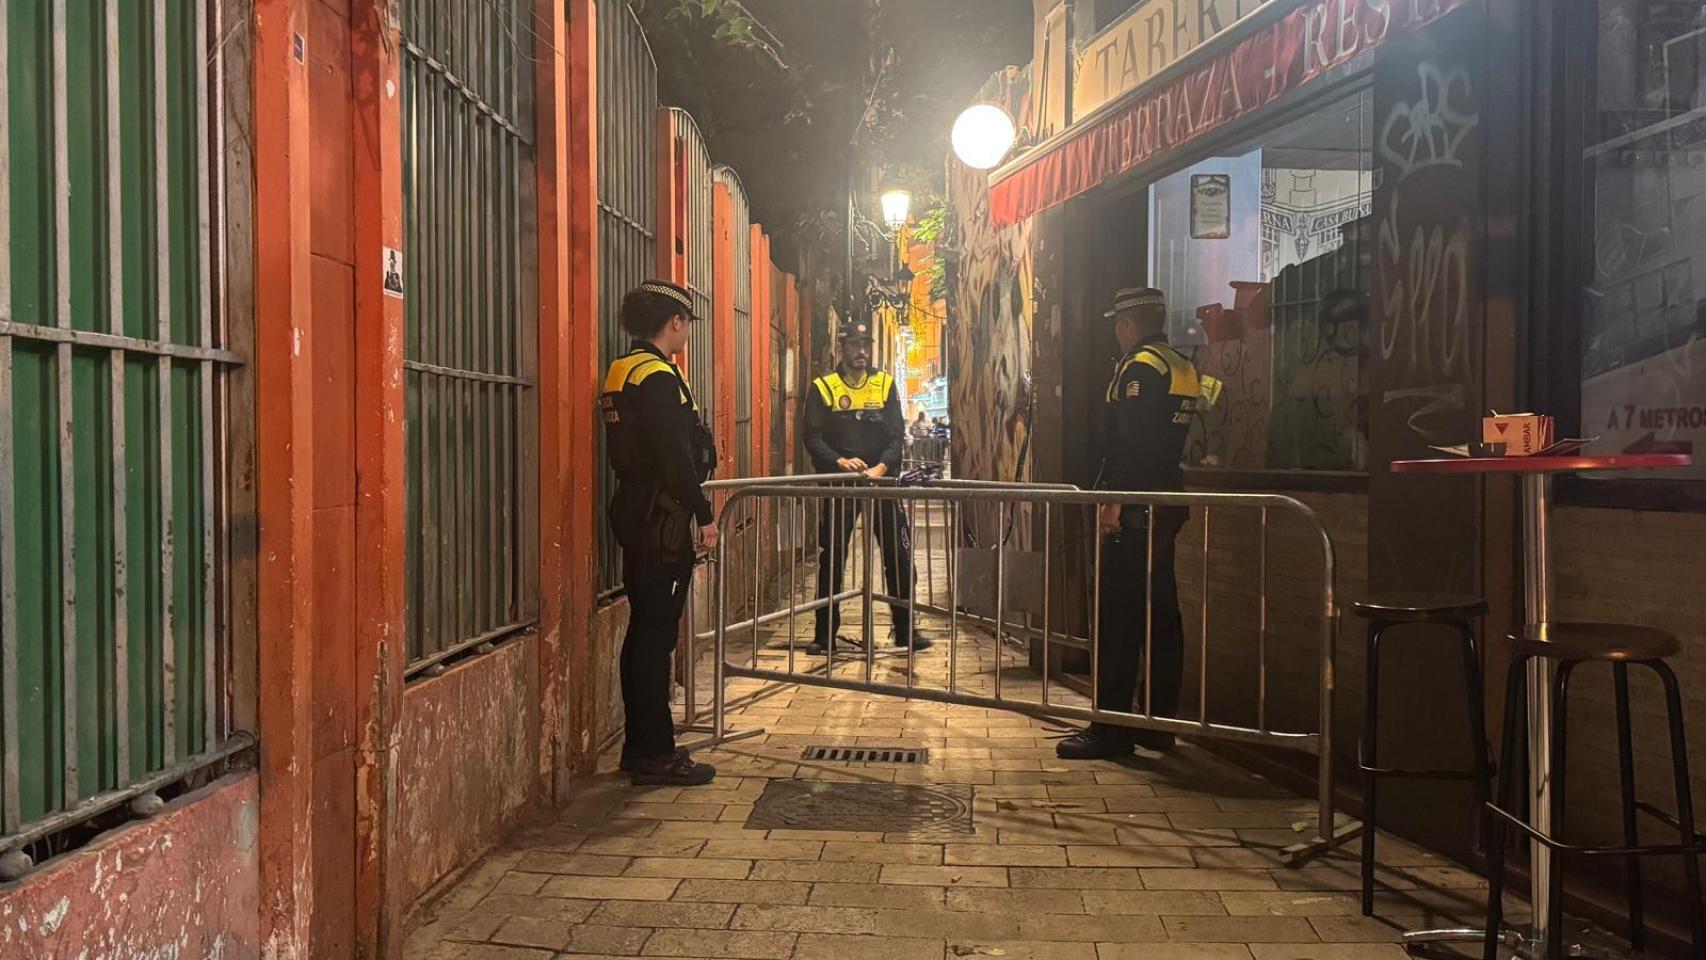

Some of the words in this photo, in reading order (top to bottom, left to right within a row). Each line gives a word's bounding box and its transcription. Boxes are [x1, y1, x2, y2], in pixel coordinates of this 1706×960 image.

[1095, 0, 1242, 98] TABER
[1606, 409, 1619, 431] A
[1624, 403, 1637, 431] 7
[1522, 422, 1532, 454] AMBAR
